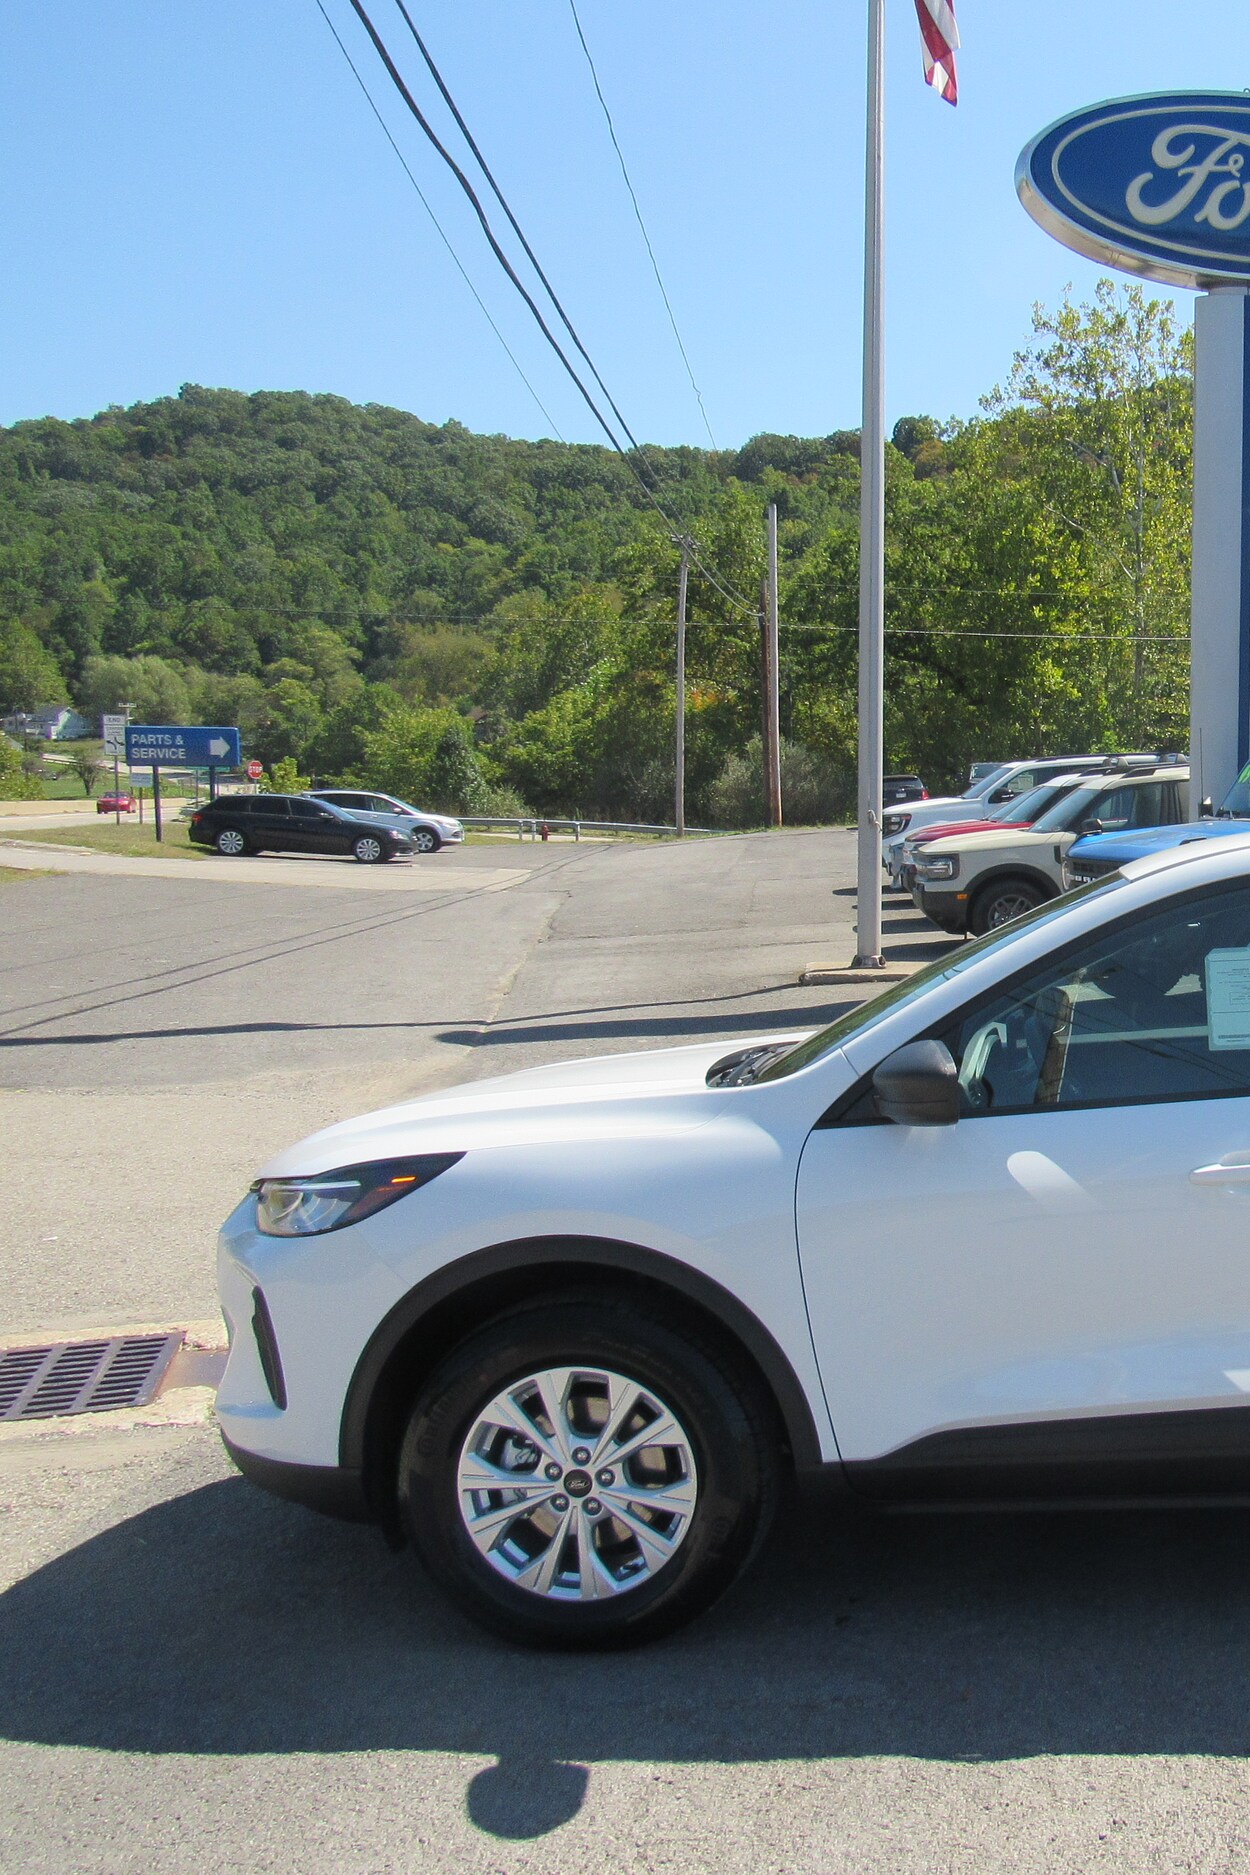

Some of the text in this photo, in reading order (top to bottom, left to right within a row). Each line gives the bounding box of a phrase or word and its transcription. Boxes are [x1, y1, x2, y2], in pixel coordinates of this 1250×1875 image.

[131, 735, 184, 745] PARTS &
[132, 749, 187, 759] SERVICE
